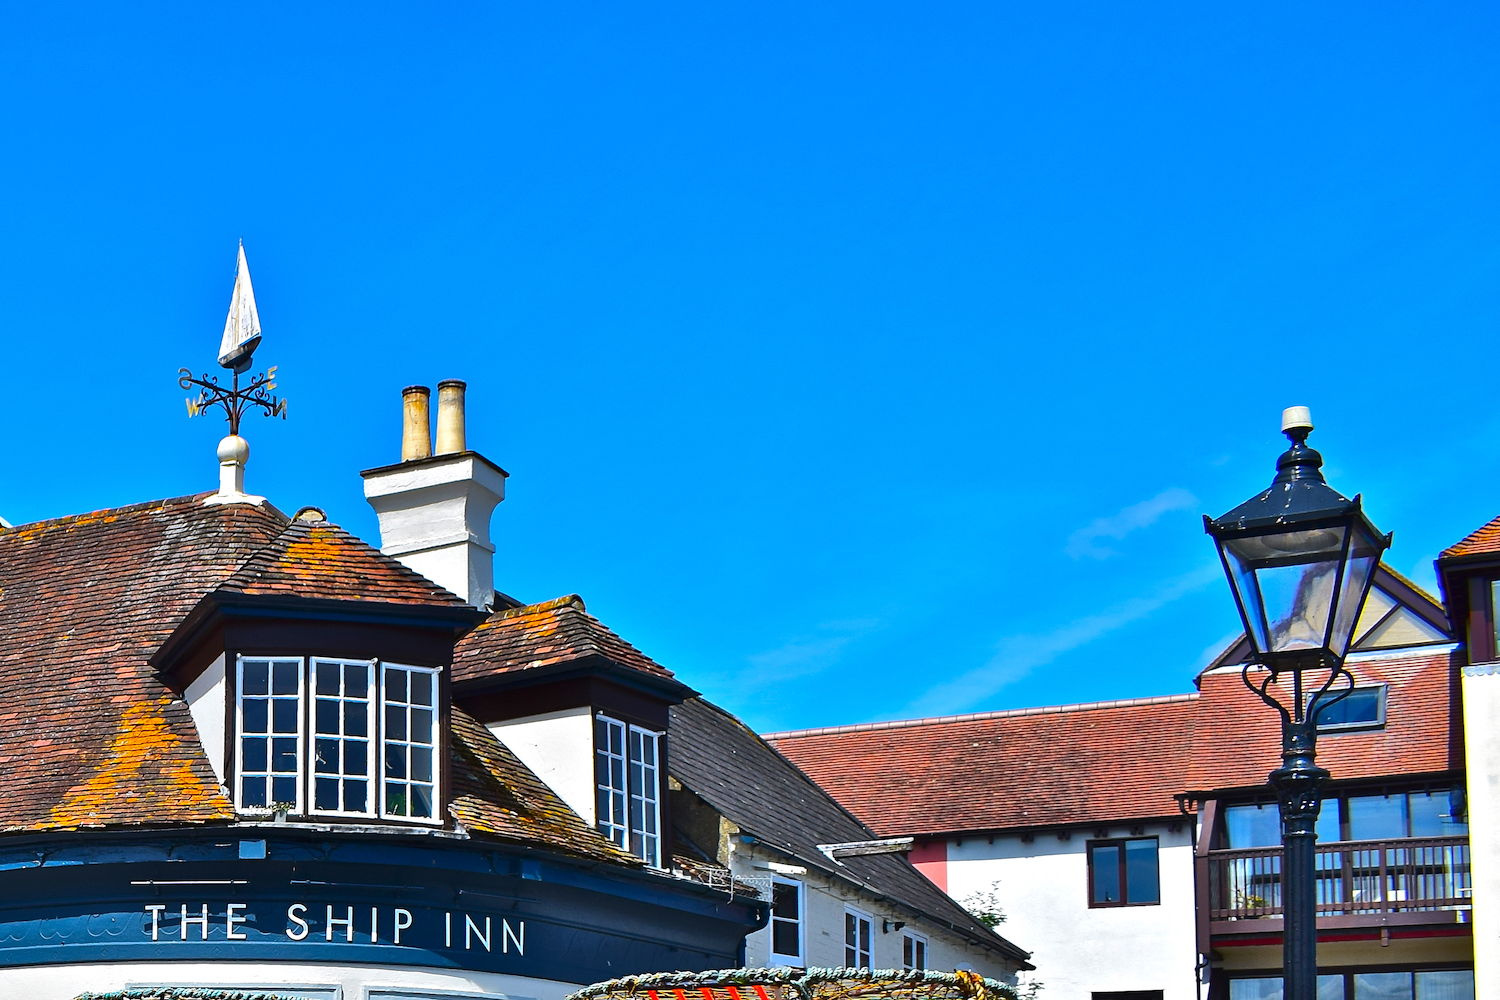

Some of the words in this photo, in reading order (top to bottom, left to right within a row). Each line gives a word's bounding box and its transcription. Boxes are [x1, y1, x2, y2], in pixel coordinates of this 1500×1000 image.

[144, 903, 248, 942] THE
[285, 903, 414, 944] SHIP
[445, 912, 526, 956] INN
